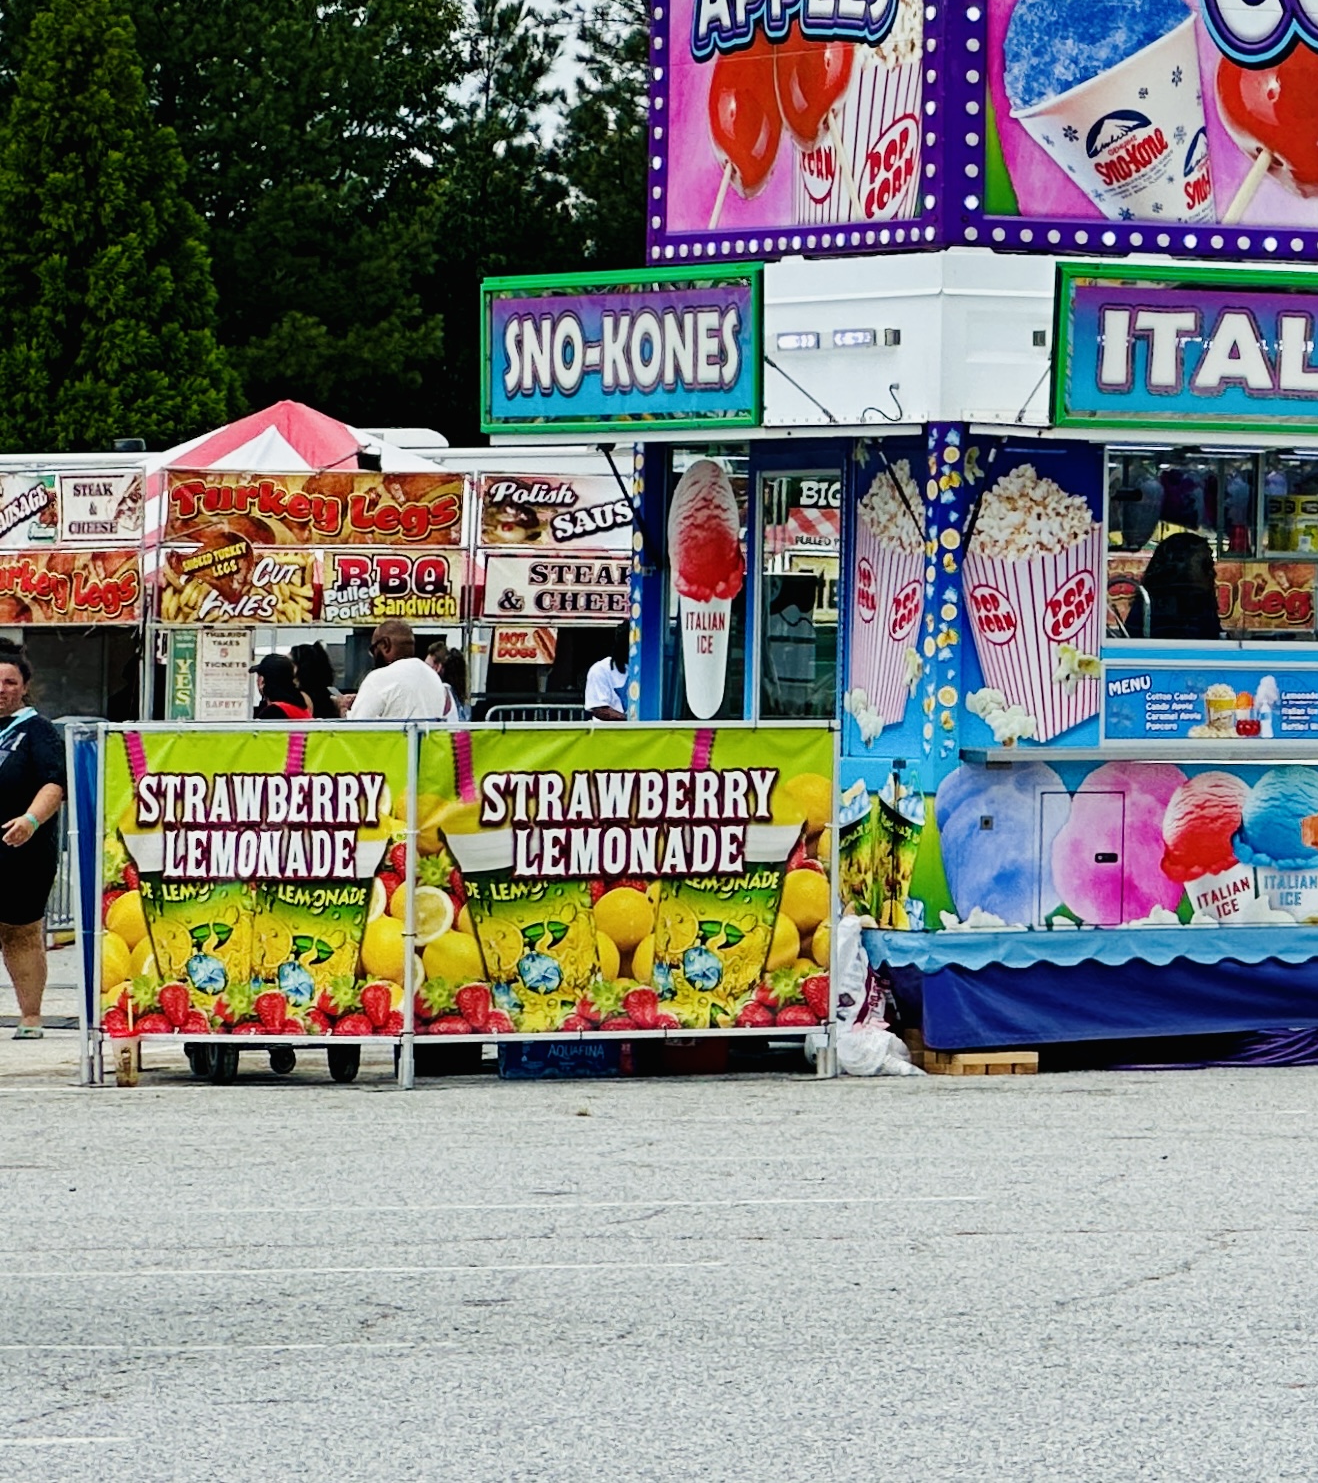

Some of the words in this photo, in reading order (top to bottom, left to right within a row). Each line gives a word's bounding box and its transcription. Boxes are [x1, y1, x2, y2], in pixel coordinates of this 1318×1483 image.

[502, 304, 742, 398] SNO-KONES
[73, 483, 113, 497] STEAK
[490, 480, 577, 506] Polish
[171, 479, 343, 535] Turkey
[349, 493, 460, 540] Legs
[69, 521, 118, 535] CHEESE
[334, 554, 453, 597] BBQ
[72, 570, 138, 618] Legs
[324, 580, 381, 604] Pulled
[498, 588, 525, 612] &
[970, 590, 1000, 615] POP
[1047, 575, 1086, 618] POP
[325, 600, 371, 621] Pork
[373, 594, 457, 617] Sandwich
[1051, 591, 1095, 638] CORN
[685, 612, 726, 631] ITALIAN
[977, 612, 1017, 635] CORN
[499, 631, 528, 645] HOT
[696, 635, 714, 655] ICE
[204, 661, 248, 669] TICKETS
[497, 647, 538, 660] DOGS
[1108, 675, 1151, 696] MENU
[137, 771, 386, 825] STRAWBERRY
[480, 766, 779, 823] STRAWBERRY
[161, 826, 359, 880] LEMONADE
[512, 825, 748, 878] LEMONADE
[1196, 875, 1251, 909] ITALIAN
[1263, 873, 1318, 892] ITALIAN
[278, 883, 367, 915] LEMONADE
[1215, 898, 1241, 919] ICE
[1278, 891, 1303, 908] ICE
[547, 1043, 606, 1060] AQUAFINA
